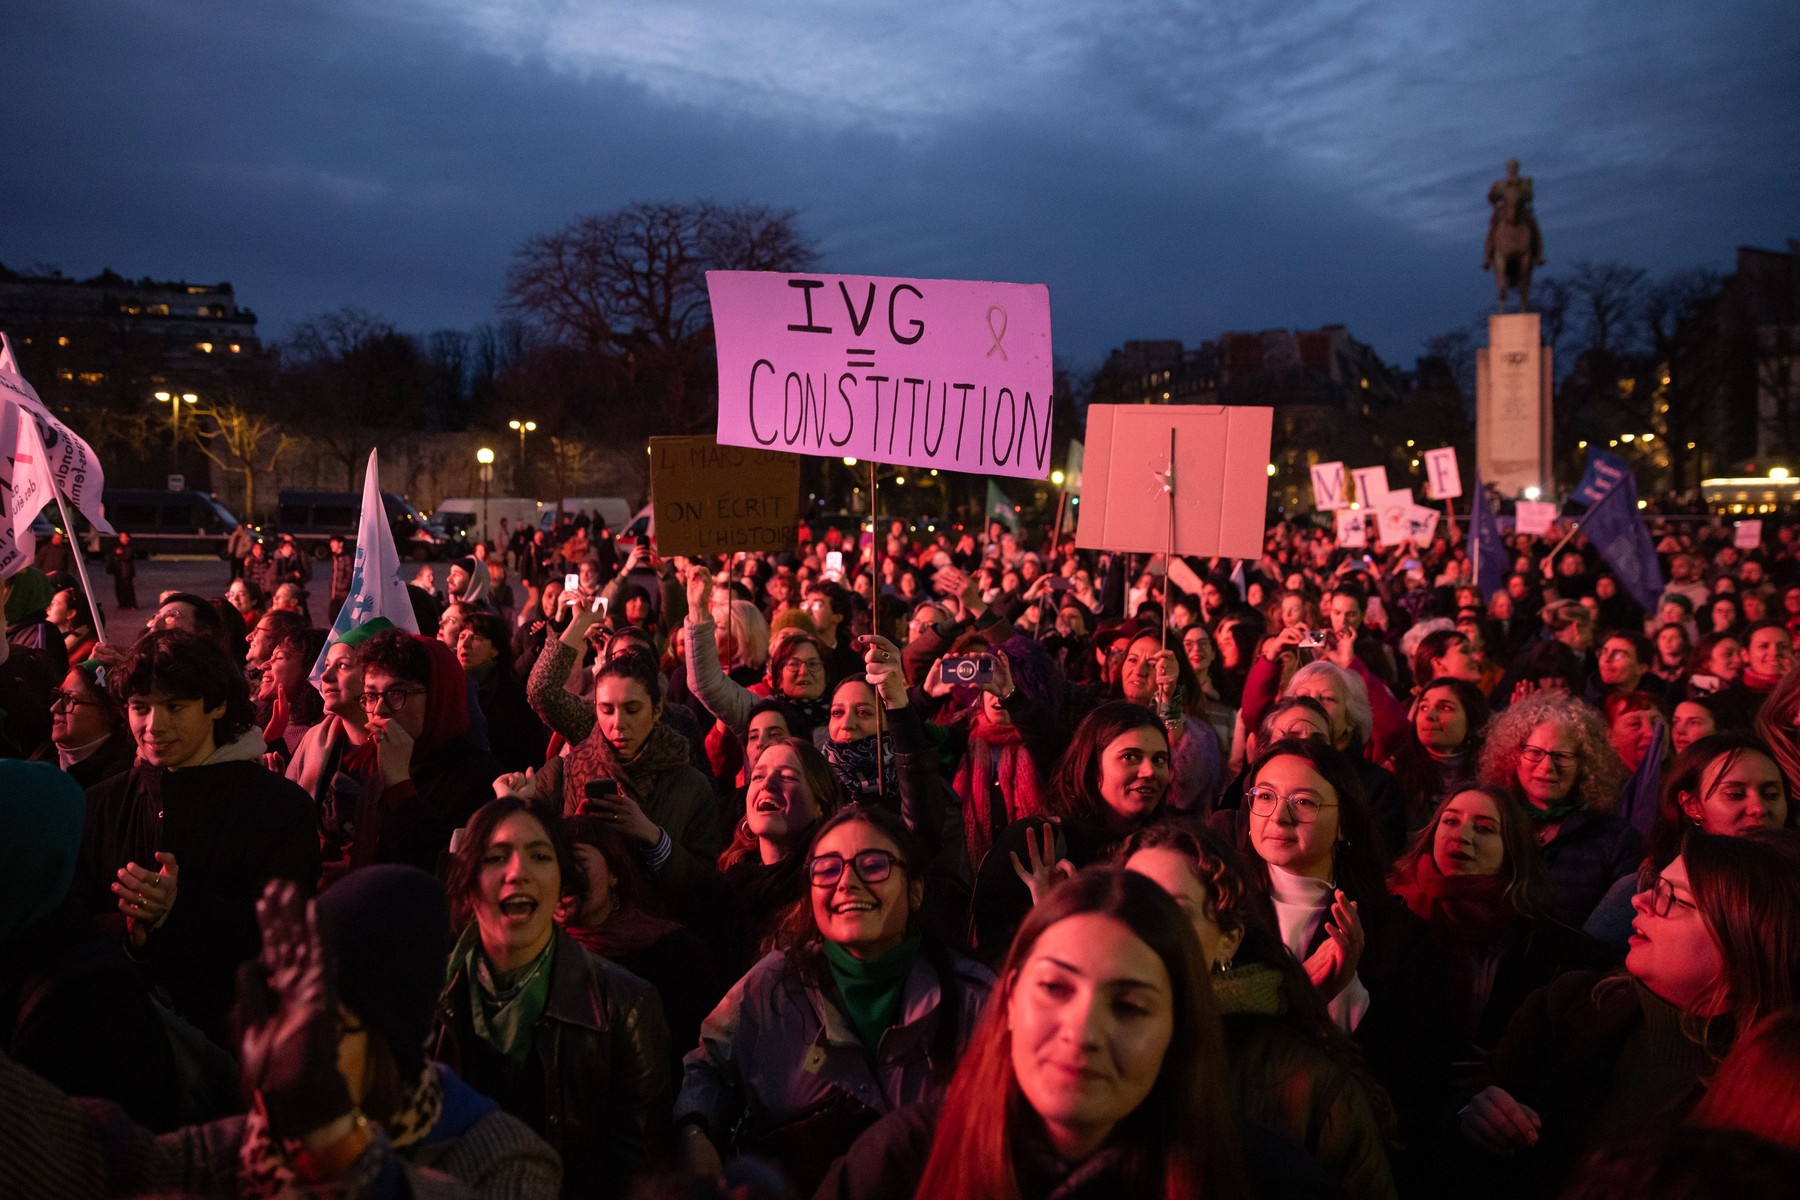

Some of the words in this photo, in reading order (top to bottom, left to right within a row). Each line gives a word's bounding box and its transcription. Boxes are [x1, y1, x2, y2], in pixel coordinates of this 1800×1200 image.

[787, 279, 925, 346] IVG
[749, 358, 1054, 471] CONSTITUTION
[1315, 467, 1346, 505] M
[1433, 453, 1449, 493] F
[665, 502, 703, 523] ON
[717, 490, 783, 520] ÉCRIT
[699, 526, 799, 548] L'HISTOIRE
